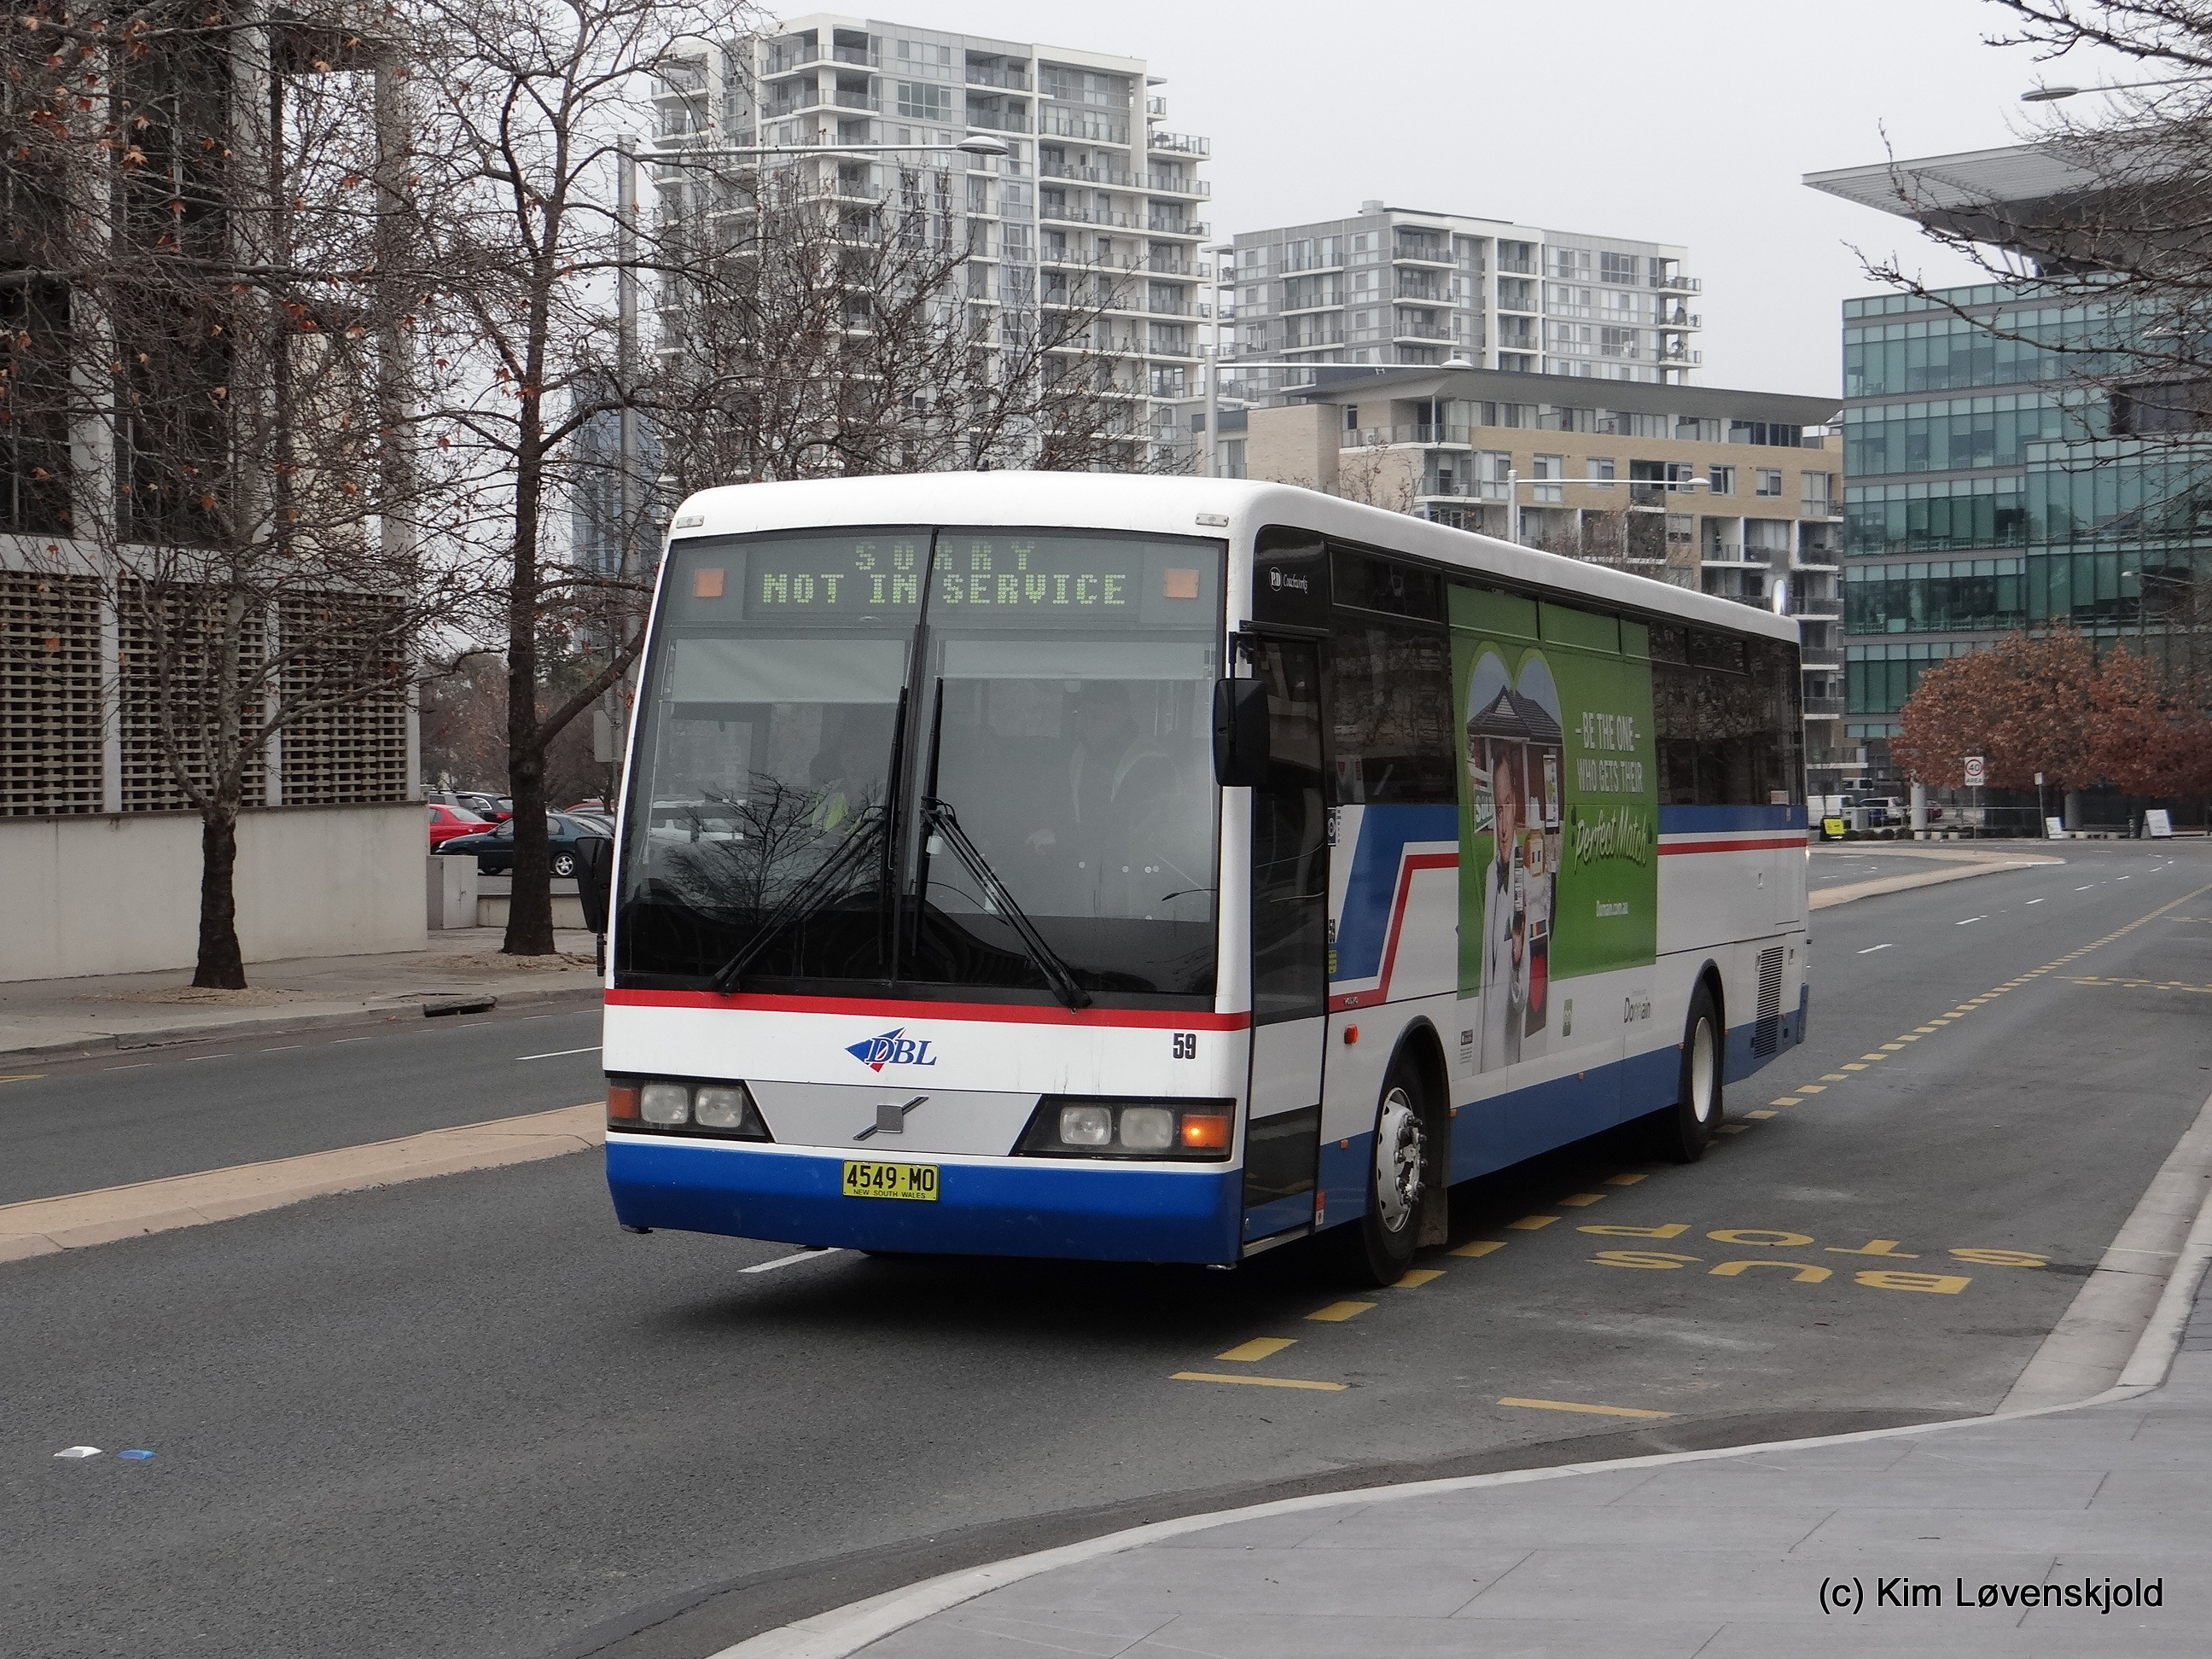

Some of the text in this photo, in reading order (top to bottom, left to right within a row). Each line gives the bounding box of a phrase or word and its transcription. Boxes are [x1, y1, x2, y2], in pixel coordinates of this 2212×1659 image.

[856, 542, 1035, 571] SORRY
[762, 573, 1126, 604] NOT IN SERVICE
[1582, 711, 1635, 752] BE THE ONE
[1576, 758, 1598, 792] WHO
[1598, 760, 1619, 793] GETS
[1620, 760, 1644, 794] THEIR
[1968, 764, 1980, 772] 40
[1574, 805, 1647, 876] Perfect Match
[1623, 997, 1651, 1023] Domain
[864, 1037, 938, 1067] DBL
[1173, 1033, 1196, 1059] 59
[1575, 1223, 2052, 1267] STOP
[1586, 1249, 1972, 1295] BUS
